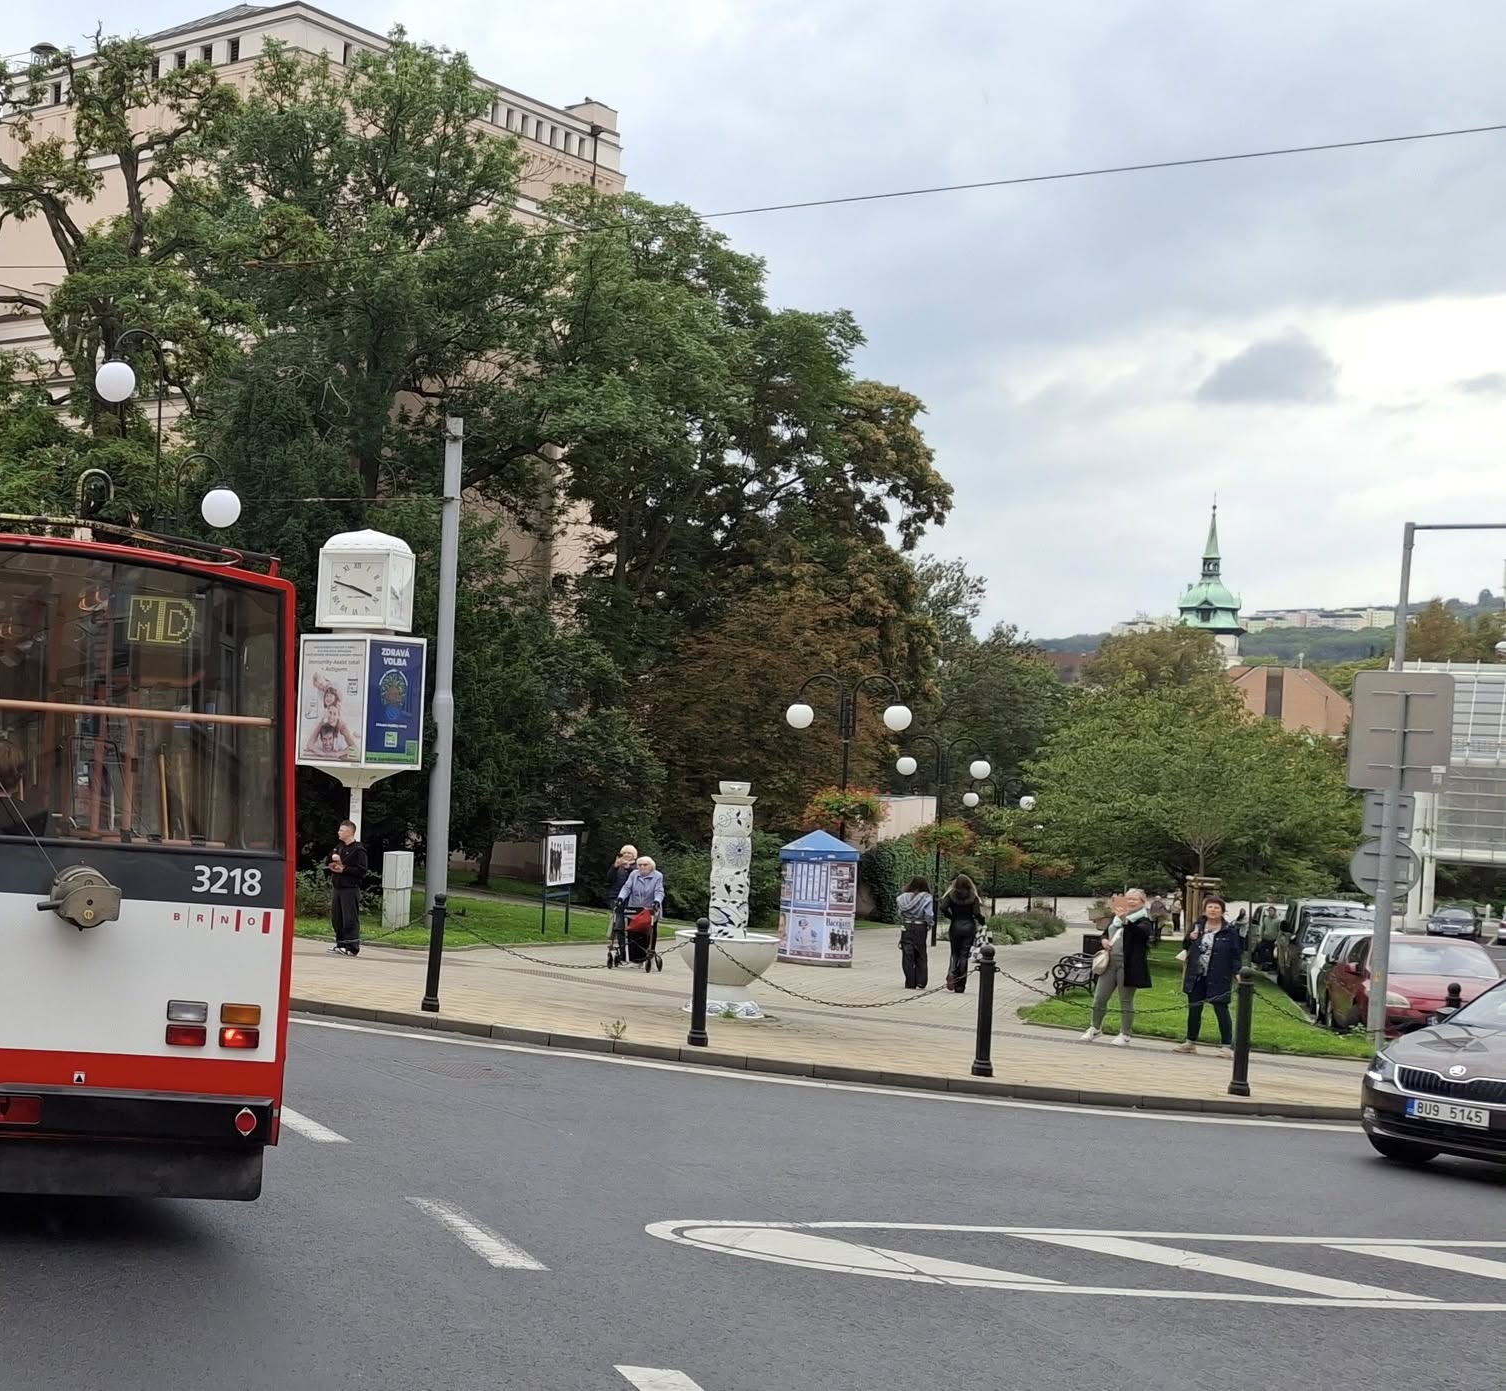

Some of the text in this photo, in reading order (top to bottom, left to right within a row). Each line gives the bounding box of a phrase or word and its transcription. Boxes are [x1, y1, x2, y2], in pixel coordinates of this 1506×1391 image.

[127, 595, 196, 644] MD
[381, 647, 410, 658] ZDRAVÁ
[384, 657, 407, 667] VOLBA
[191, 864, 262, 897] 3218
[1417, 1102, 1483, 1123] 8U9 5145
